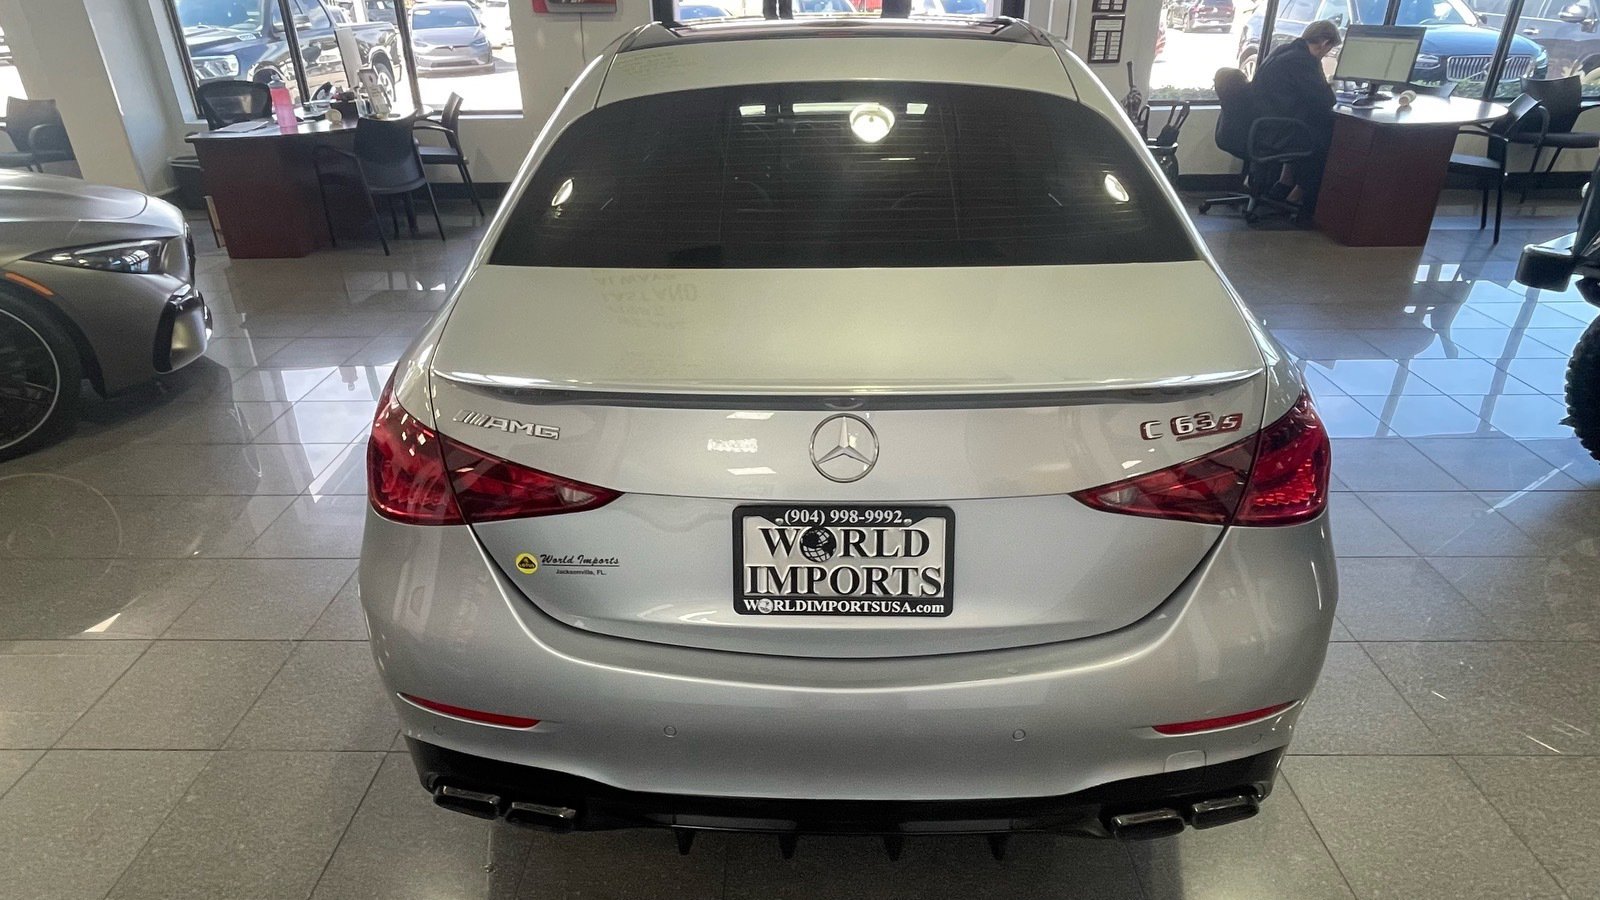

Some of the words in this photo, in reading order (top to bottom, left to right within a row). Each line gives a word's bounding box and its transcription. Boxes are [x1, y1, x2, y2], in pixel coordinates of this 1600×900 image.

[484, 416, 560, 440] AMG
[1140, 420, 1163, 440] C
[784, 509, 826, 526] (904)
[830, 509, 903, 524] 998-9992
[759, 526, 930, 563] WORLD
[540, 554, 574, 564] World
[577, 554, 619, 566] Imports
[746, 566, 942, 597] IMPORTS
